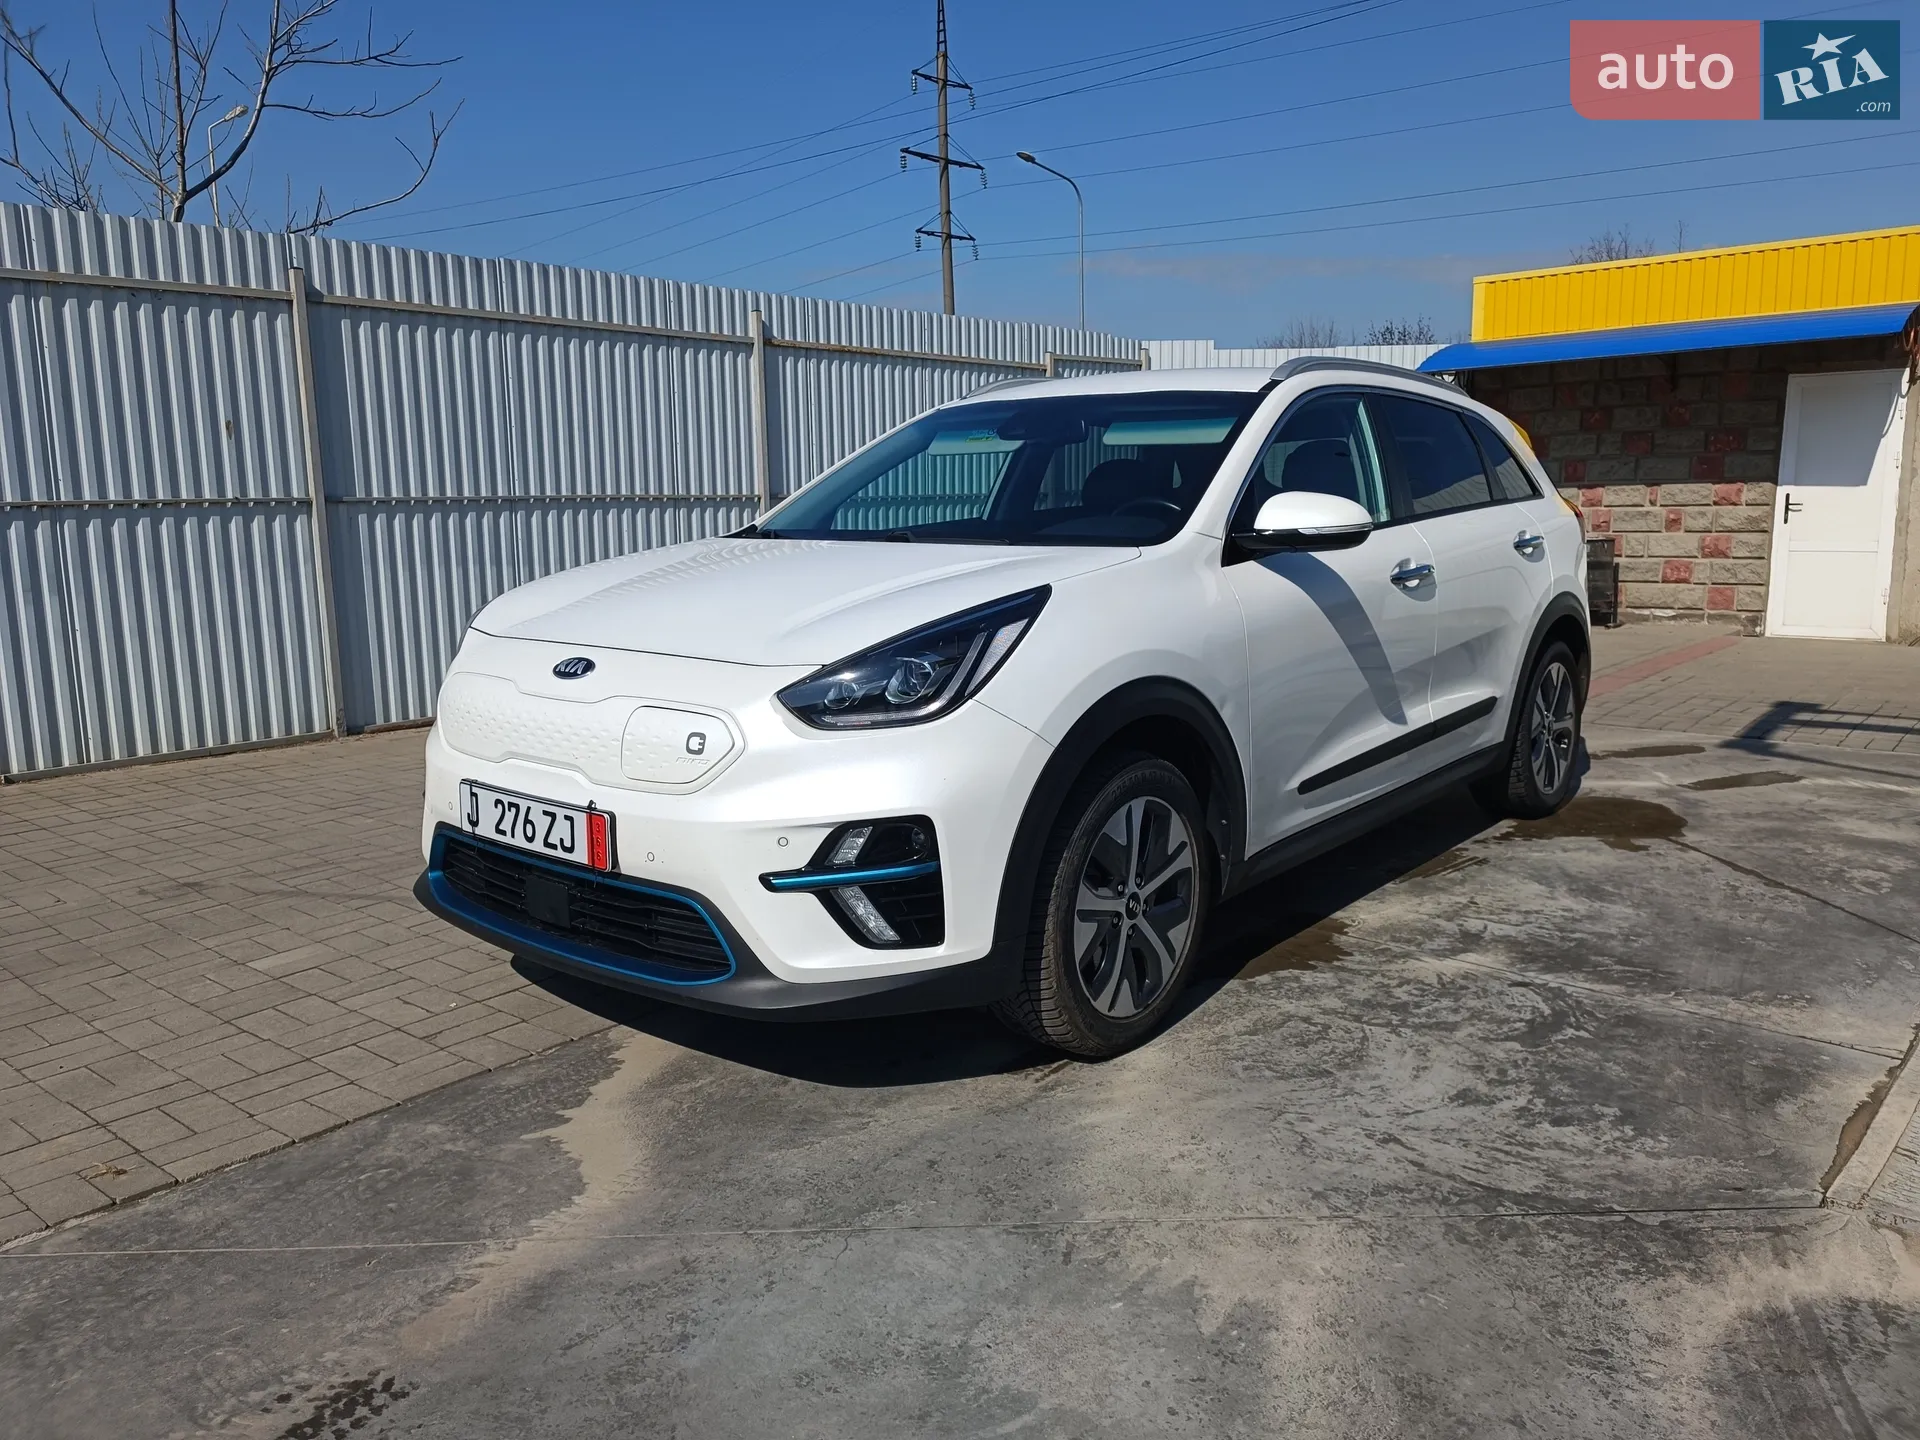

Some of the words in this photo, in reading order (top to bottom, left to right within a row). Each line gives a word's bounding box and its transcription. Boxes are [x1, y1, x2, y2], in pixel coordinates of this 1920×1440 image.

[556, 658, 587, 675] KIA
[493, 798, 536, 844] 276
[542, 809, 575, 854] ZJ
